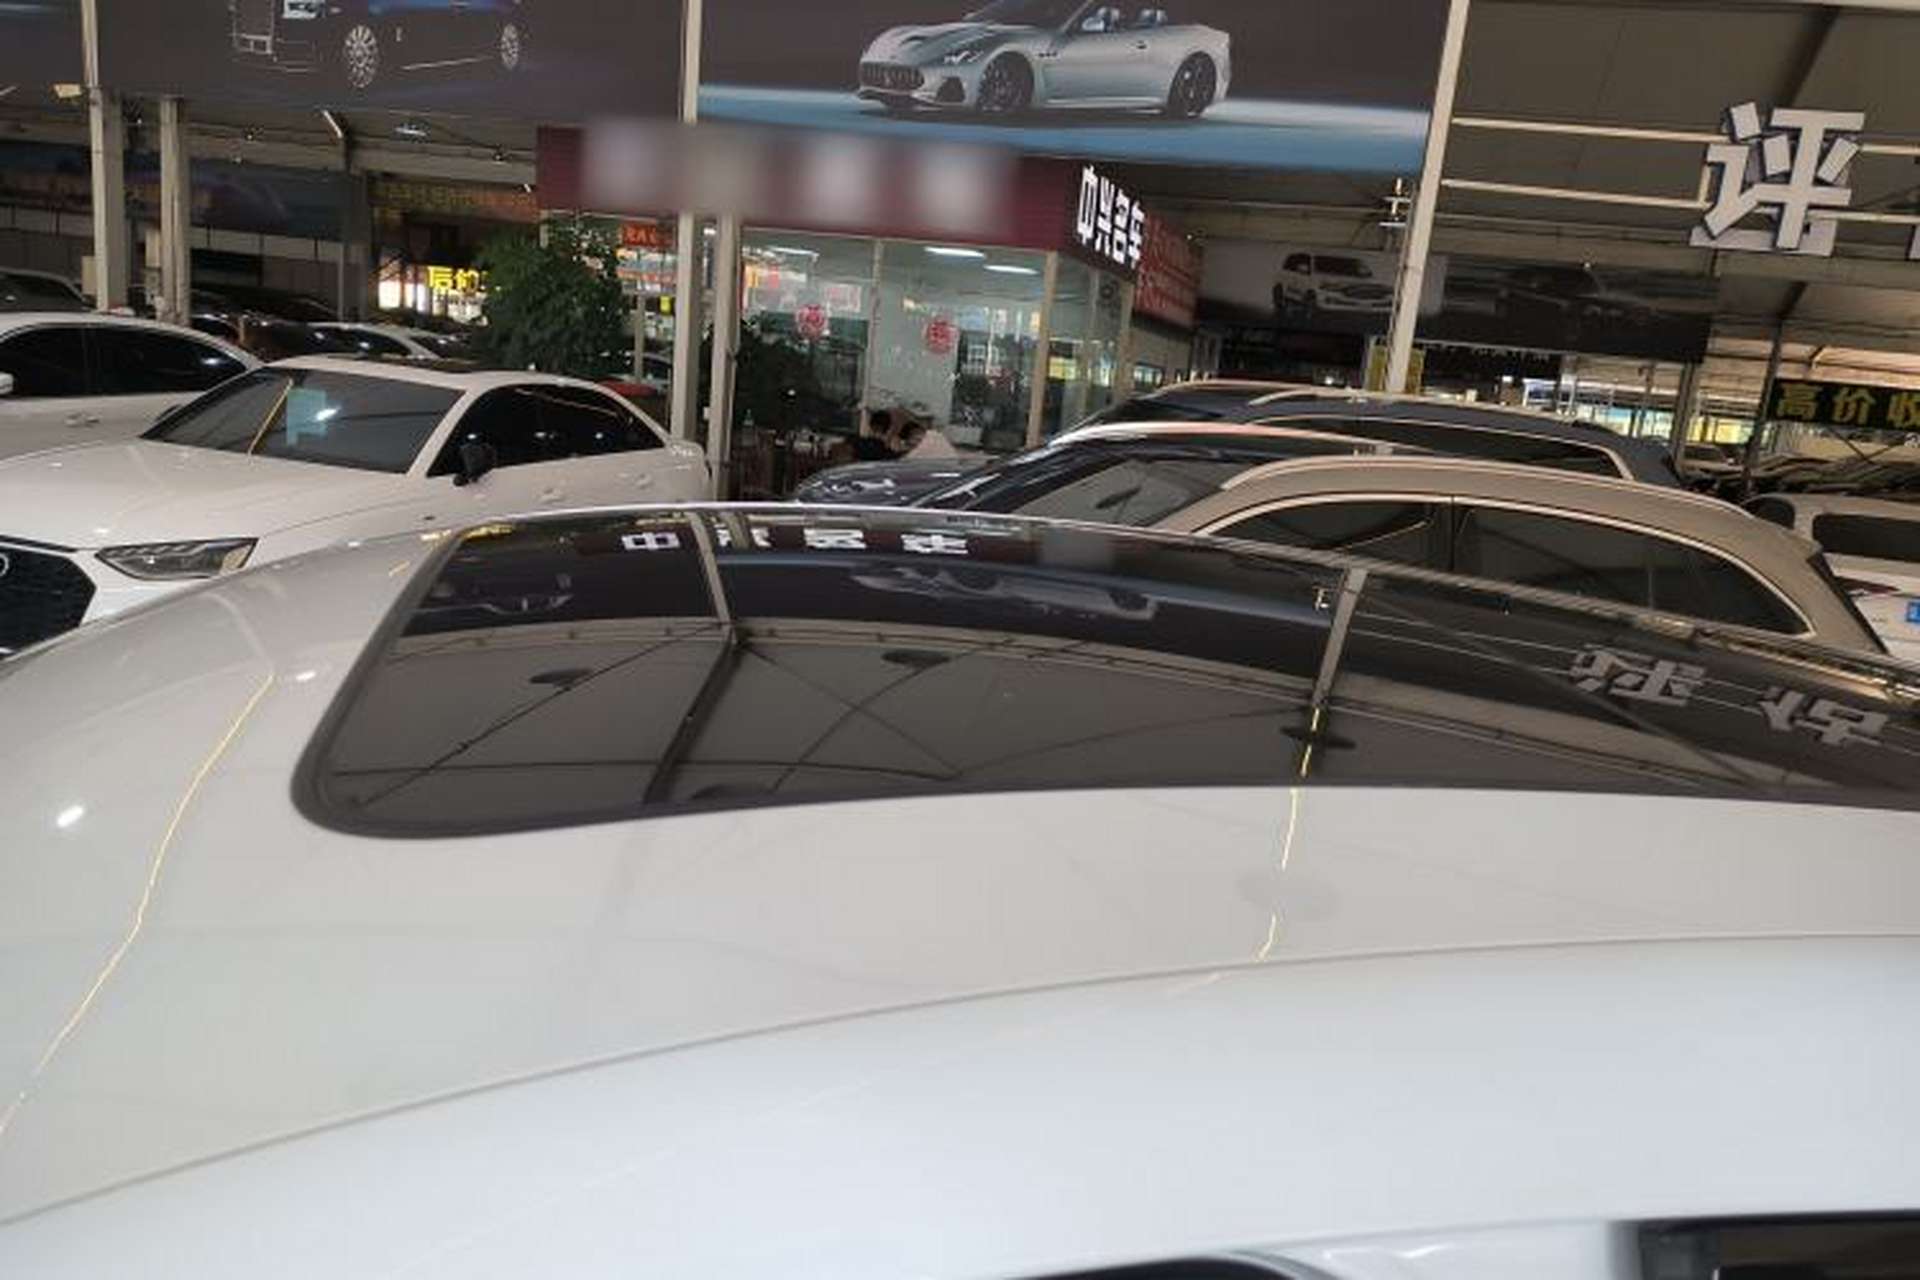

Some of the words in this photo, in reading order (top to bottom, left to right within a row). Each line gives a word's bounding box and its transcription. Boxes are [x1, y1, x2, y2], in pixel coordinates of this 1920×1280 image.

[1077, 164, 1145, 270] 中兴名车
[1688, 100, 1920, 258] 评
